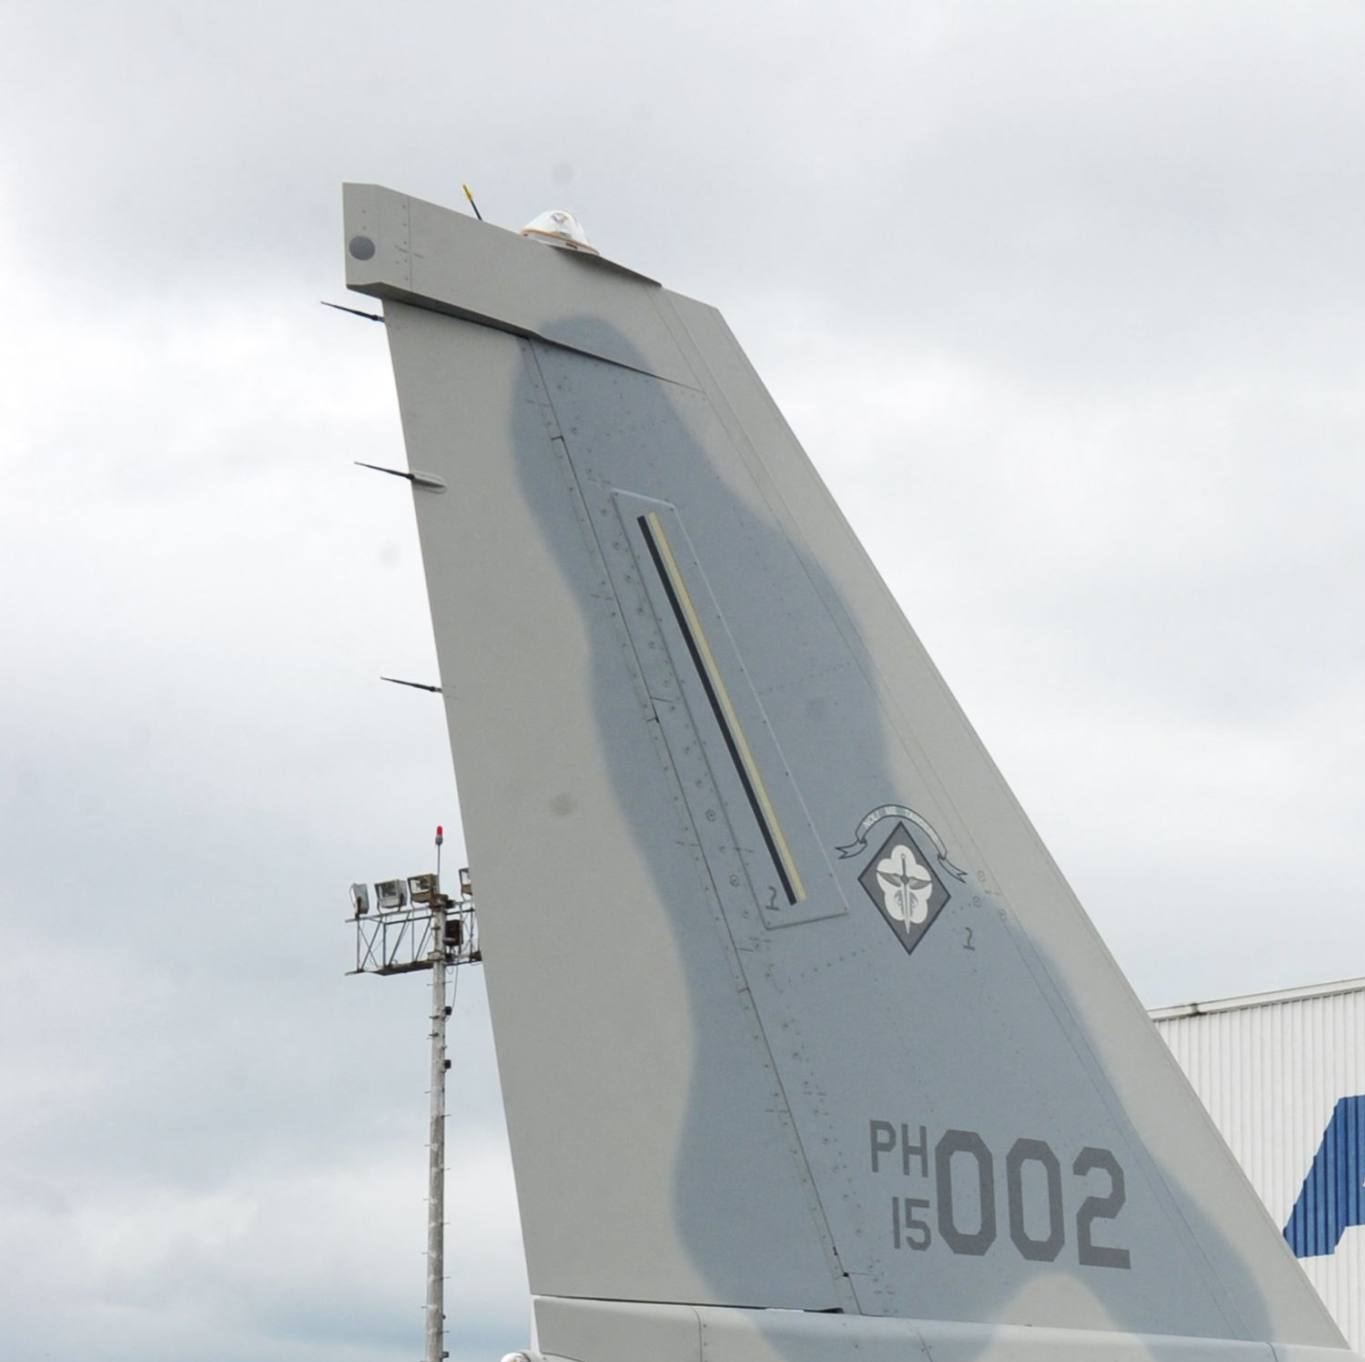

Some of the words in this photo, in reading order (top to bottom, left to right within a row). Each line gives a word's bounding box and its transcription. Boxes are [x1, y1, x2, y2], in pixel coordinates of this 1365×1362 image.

[869, 1119, 929, 1178] PH
[892, 1196, 932, 1252] 15
[934, 1129, 1132, 1270] 002
